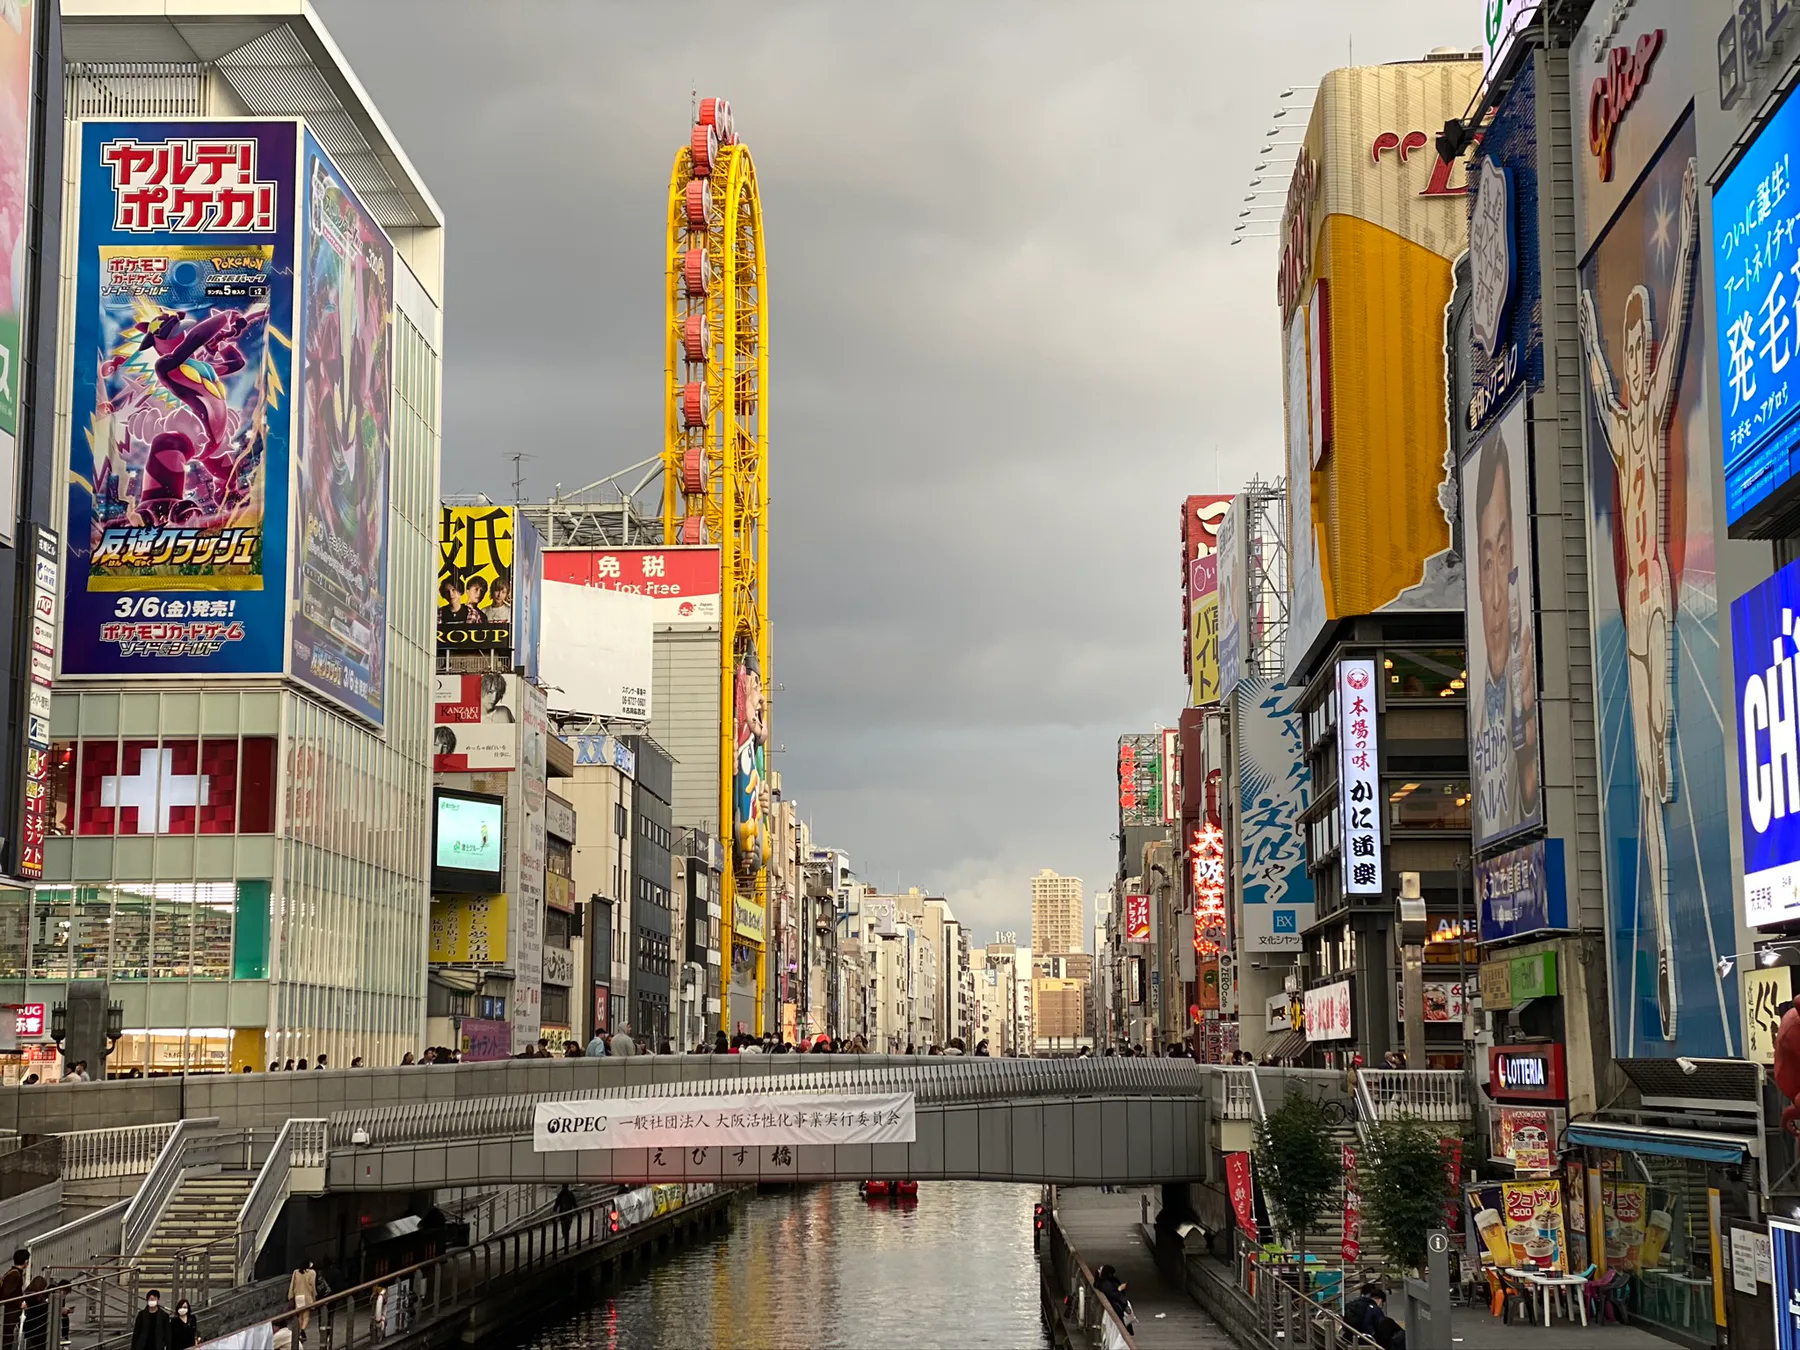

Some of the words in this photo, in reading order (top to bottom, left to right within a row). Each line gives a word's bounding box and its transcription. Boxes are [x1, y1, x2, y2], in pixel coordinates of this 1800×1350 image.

[118, 186, 273, 230] ポケカ!
[108, 256, 168, 272] ポケモン
[112, 273, 163, 285] カードゲーム
[102, 623, 243, 640] ポケモンカードゲーム
[1349, 696, 1370, 772] 本場の味
[1137, 897, 1149, 924] ツルハ
[1276, 916, 1294, 927] BX
[1506, 1058, 1545, 1085] LOTTERIA
[618, 1113, 710, 1129] 一般社団法人
[715, 1109, 901, 1129] 大阪活性化事業実行委員会
[1506, 1188, 1559, 1209] タコドリ
